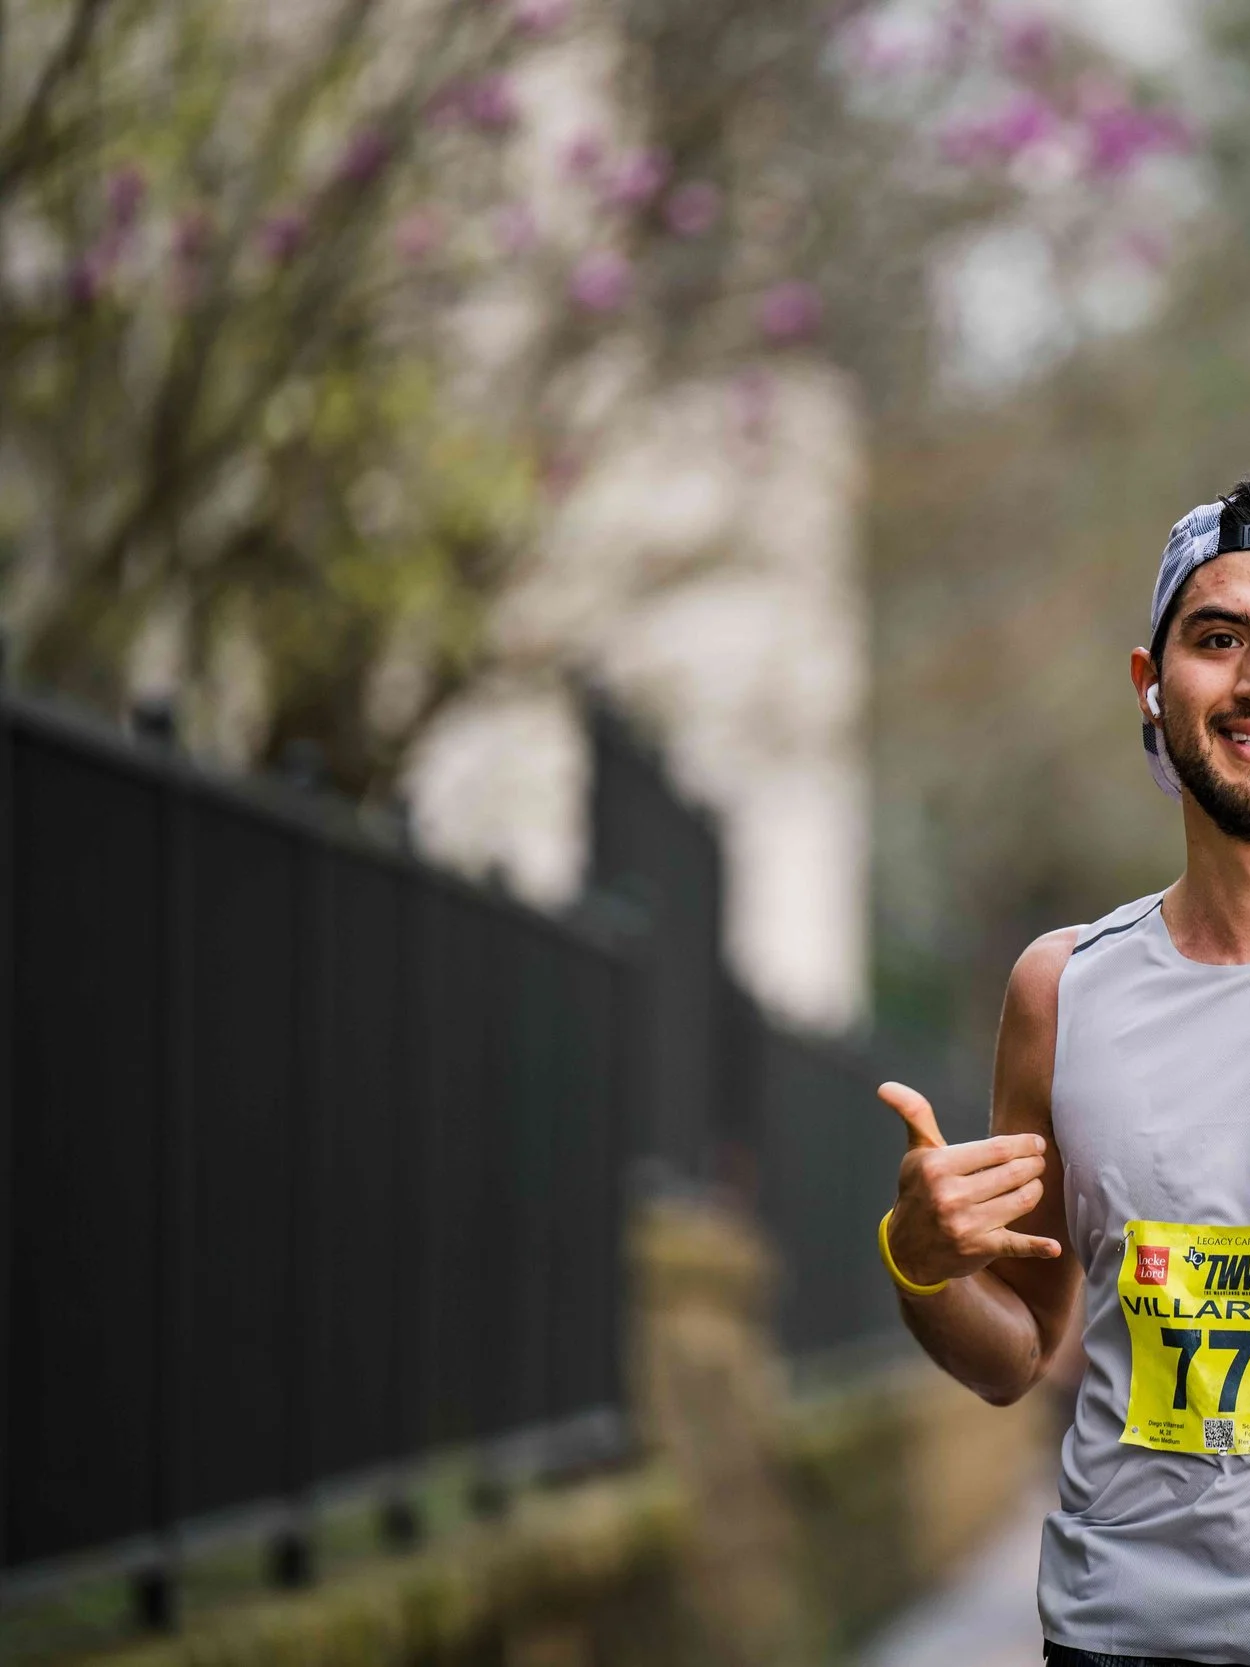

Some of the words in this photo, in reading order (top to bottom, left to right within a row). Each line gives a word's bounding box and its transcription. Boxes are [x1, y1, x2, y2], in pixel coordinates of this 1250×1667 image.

[1197, 1236, 1234, 1245] LEGACY
[1138, 1253, 1166, 1266] Locke
[1140, 1266, 1165, 1278] Lord
[1161, 1437, 1181, 1445] Medium
